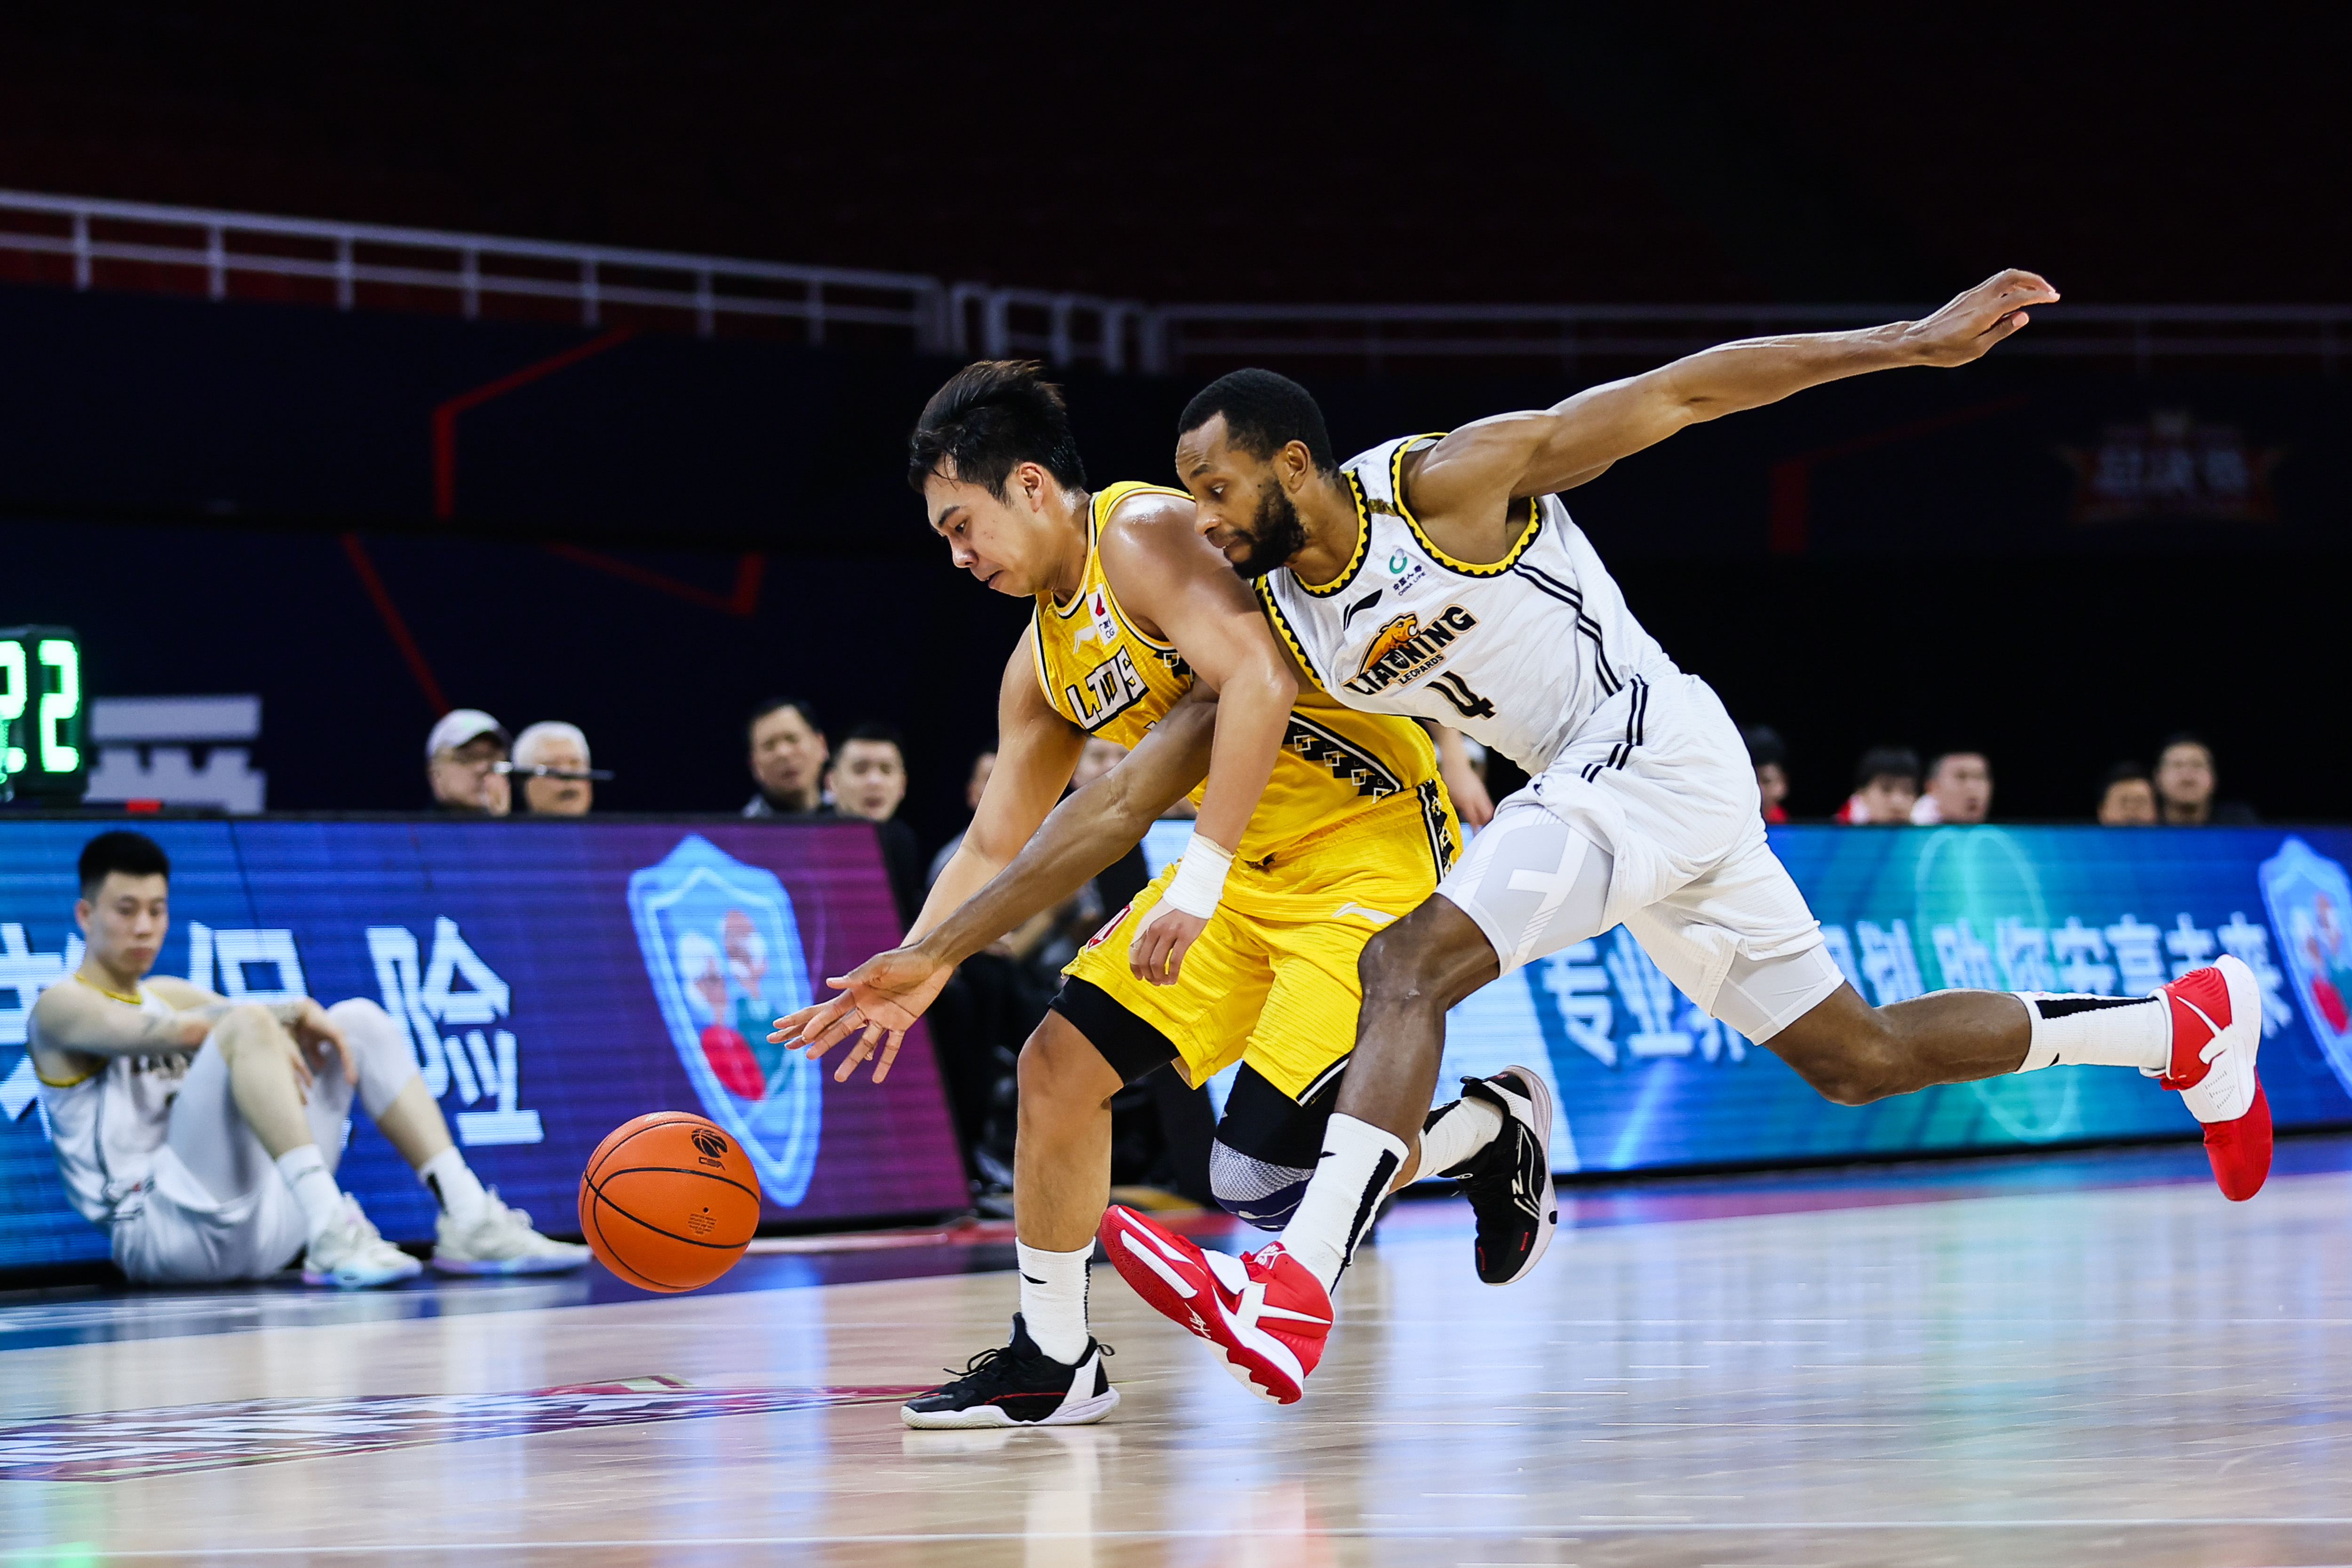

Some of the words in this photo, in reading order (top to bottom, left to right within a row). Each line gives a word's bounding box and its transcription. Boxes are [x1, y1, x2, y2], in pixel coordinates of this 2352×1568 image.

[1342, 606, 1478, 695] LIAONING
[1398, 654, 1444, 685] LEOPARDS
[1424, 670, 1497, 720] 4
